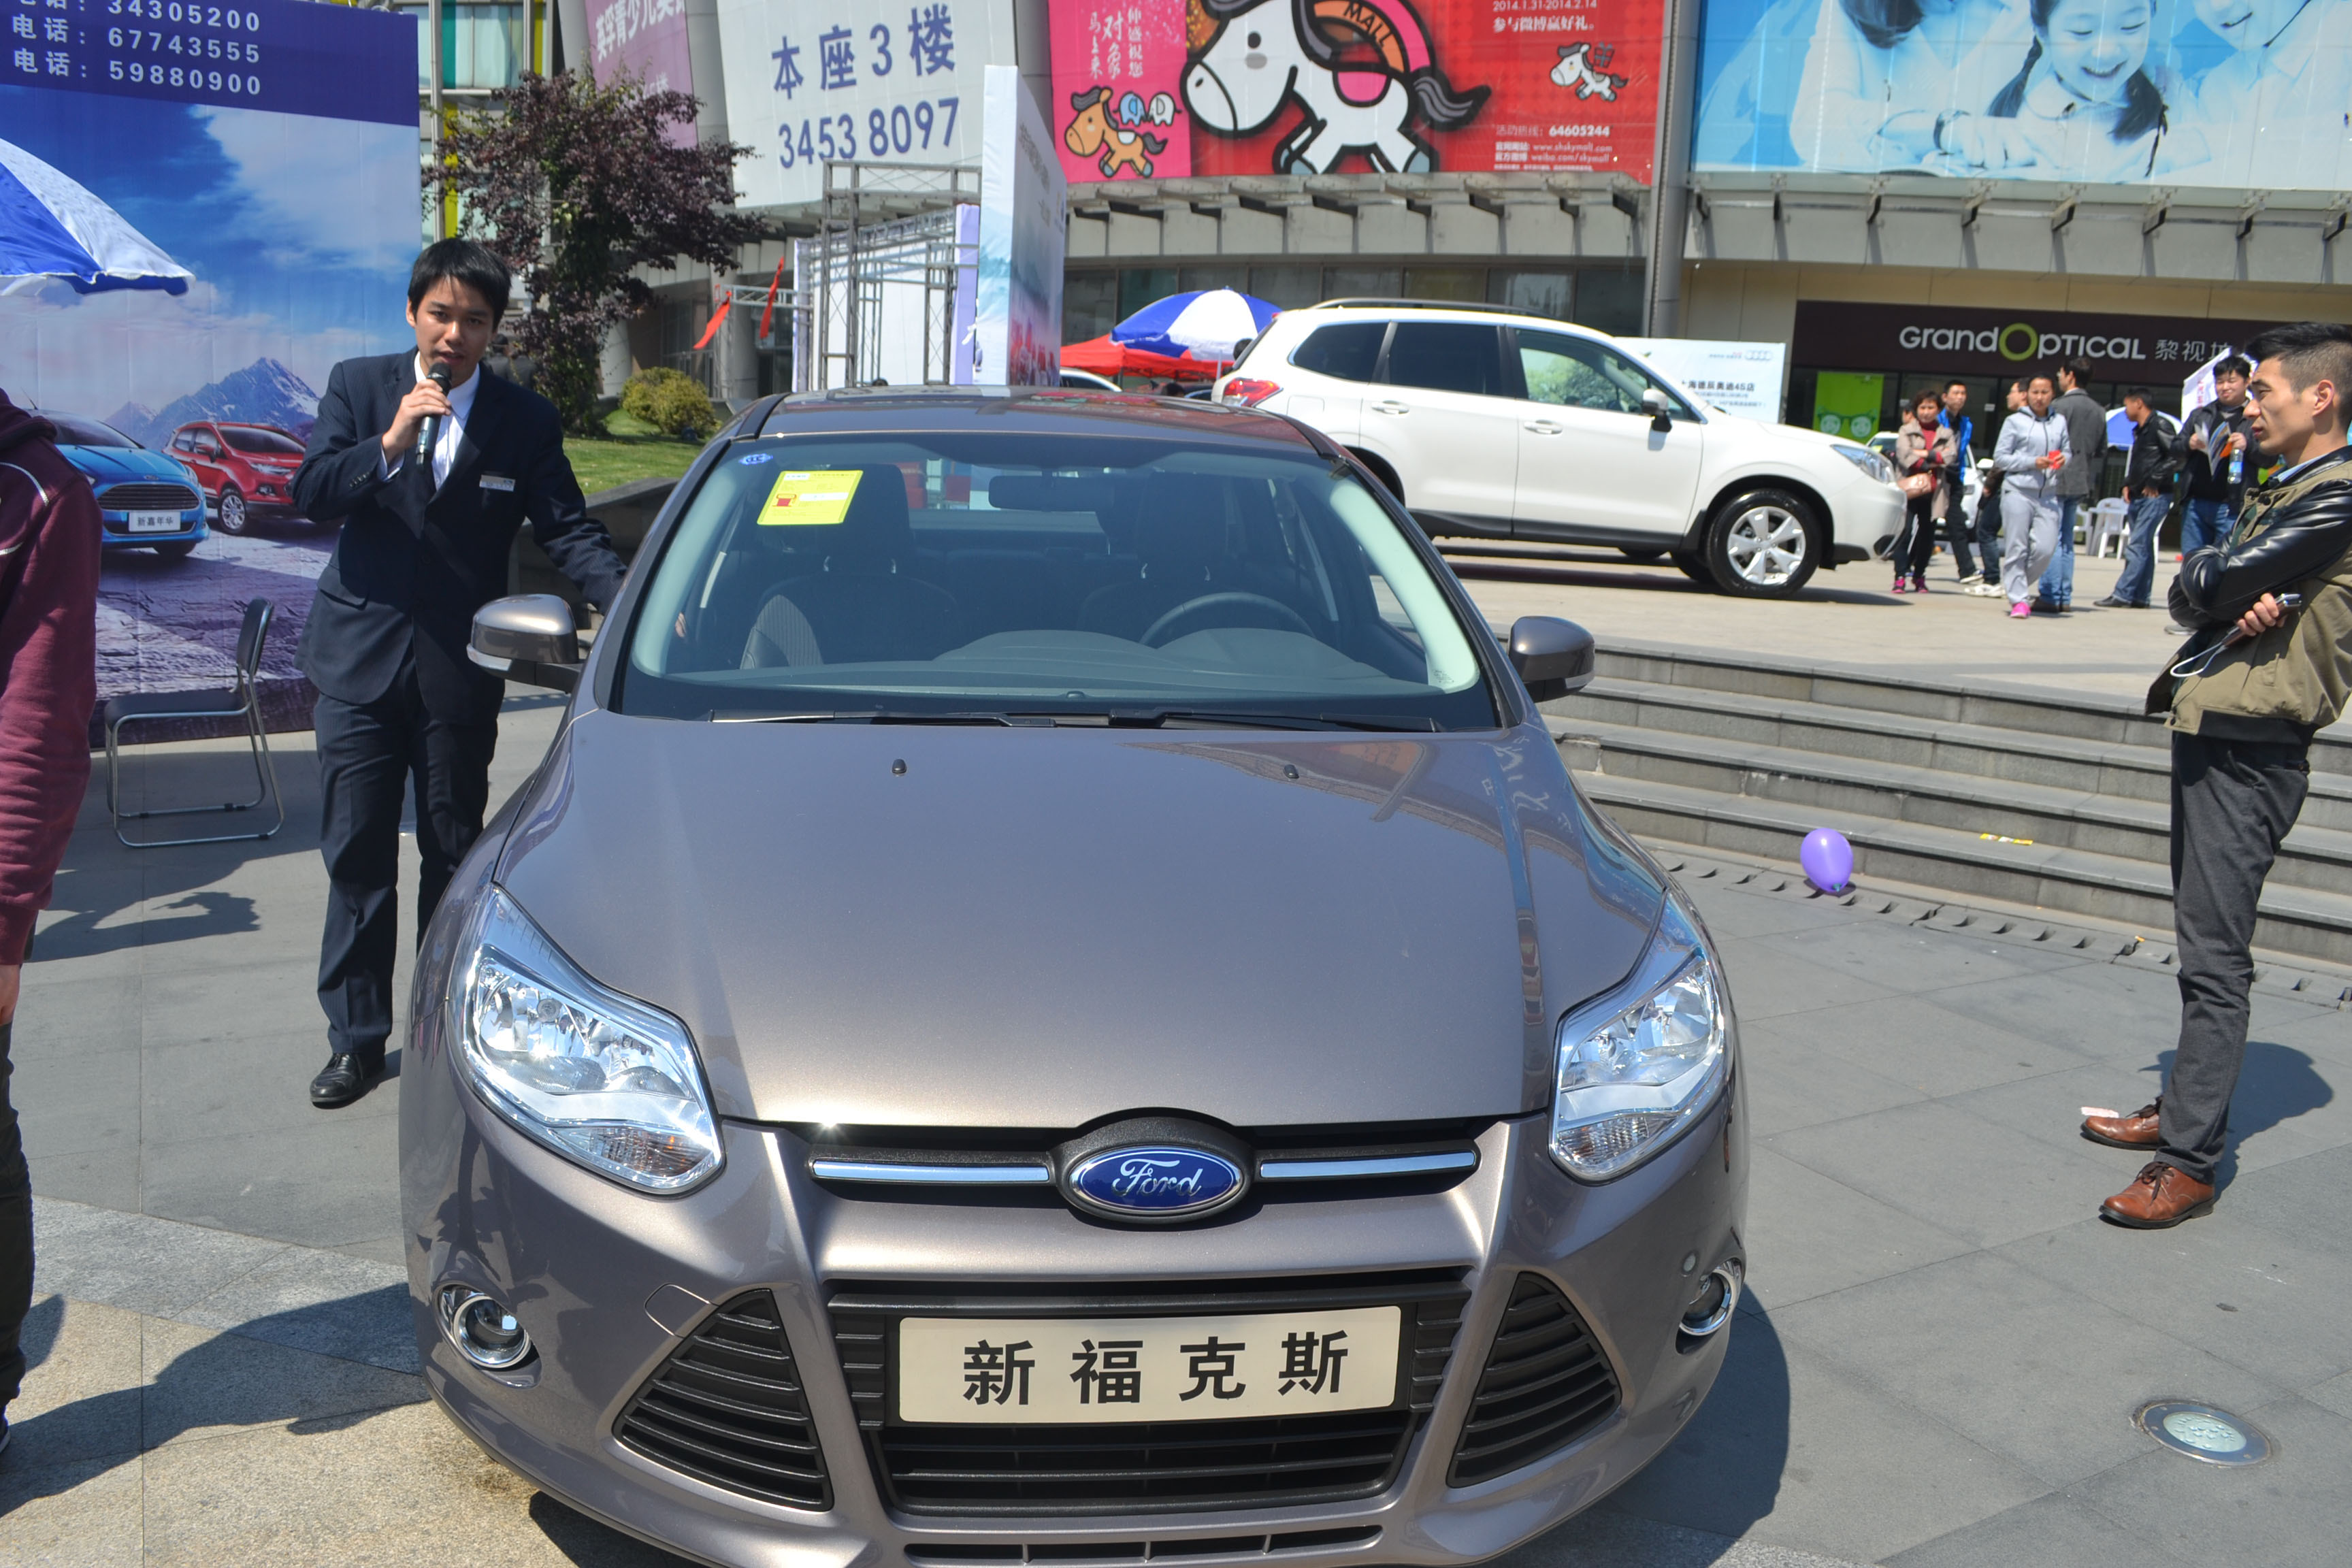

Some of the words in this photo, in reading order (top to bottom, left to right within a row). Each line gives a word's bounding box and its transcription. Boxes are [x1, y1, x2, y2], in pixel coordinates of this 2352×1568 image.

[108, 0, 259, 31] 34305200
[1344, 0, 1393, 47] MALL
[108, 27, 259, 63] 67743555
[771, 3, 956, 100] 本座3楼
[109, 60, 261, 95] 59880900
[779, 113, 857, 169] 3453
[869, 97, 959, 157] 8097
[1549, 125, 1610, 137] 64605244
[137, 517, 174, 527] 新嘉年华
[1111, 1158, 1203, 1196] Ford
[962, 1329, 1349, 1406] 新福克斯
